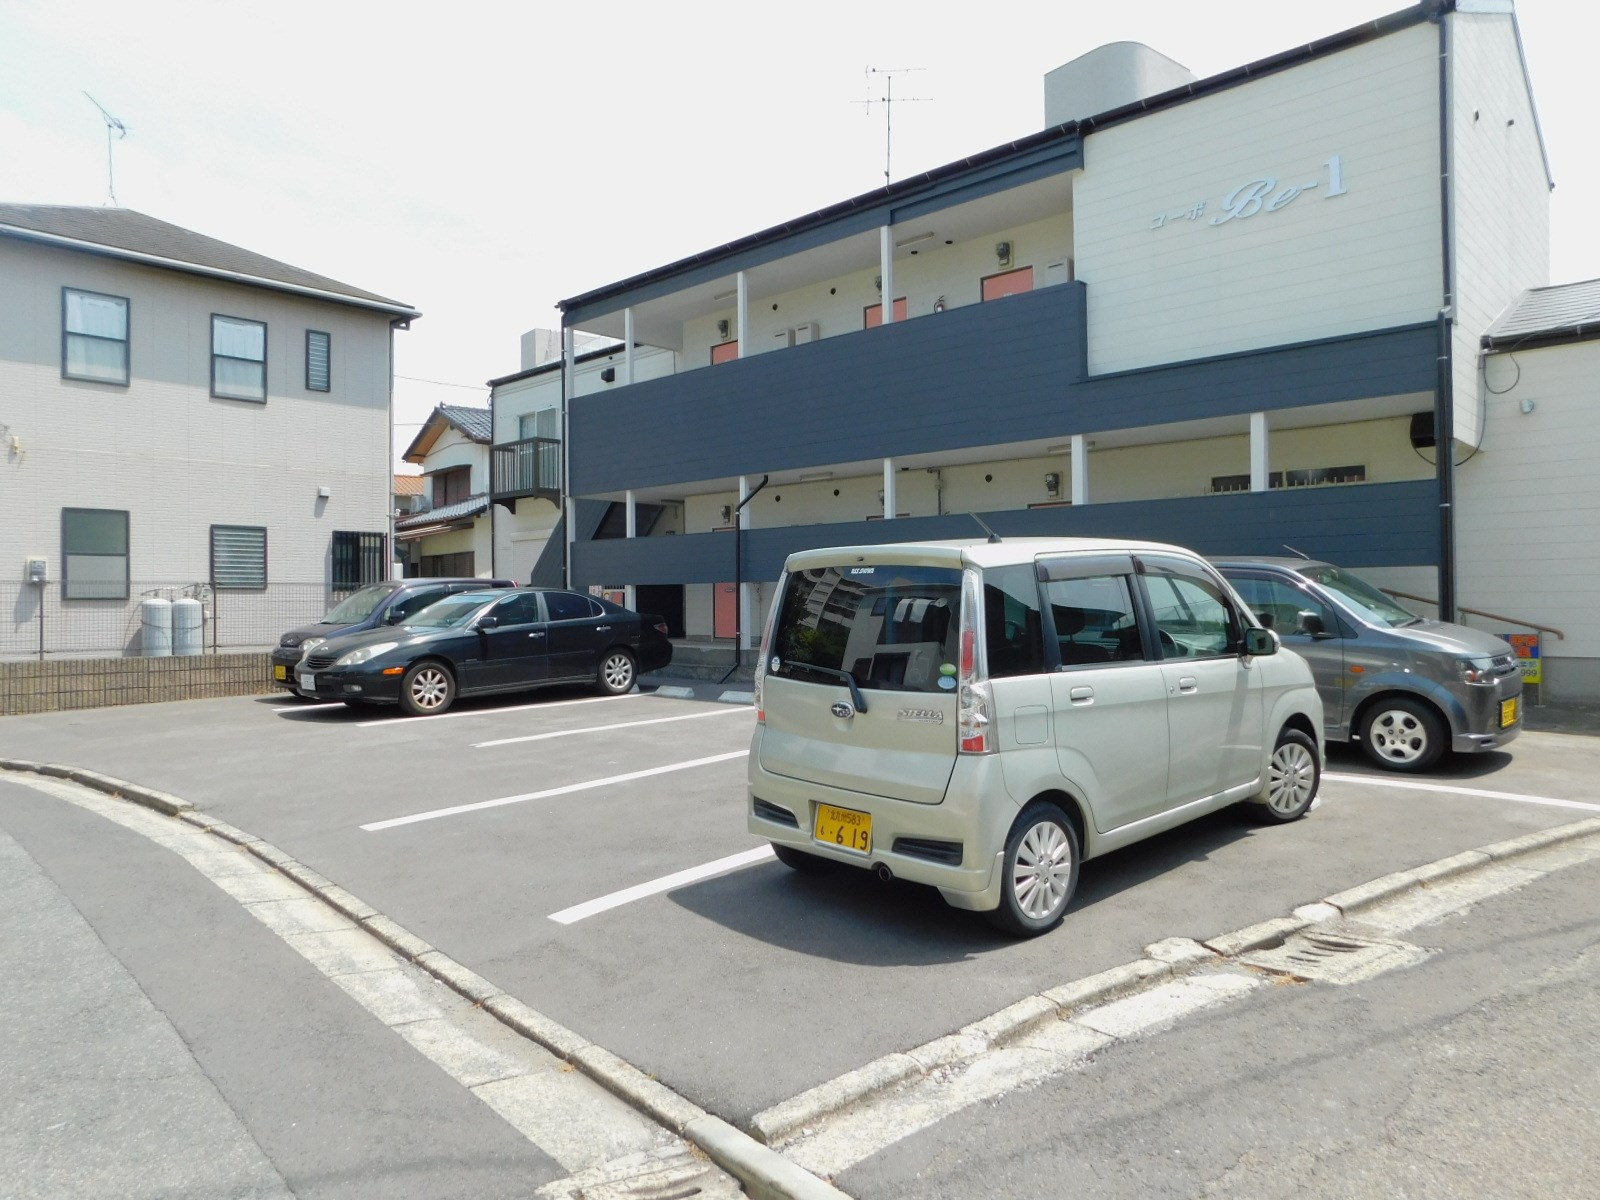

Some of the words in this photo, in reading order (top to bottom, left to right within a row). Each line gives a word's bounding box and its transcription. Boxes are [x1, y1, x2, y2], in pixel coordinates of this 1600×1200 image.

[1151, 200, 1206, 229] コーポ
[1209, 154, 1347, 226] Be-1
[898, 709, 943, 719] STELLA
